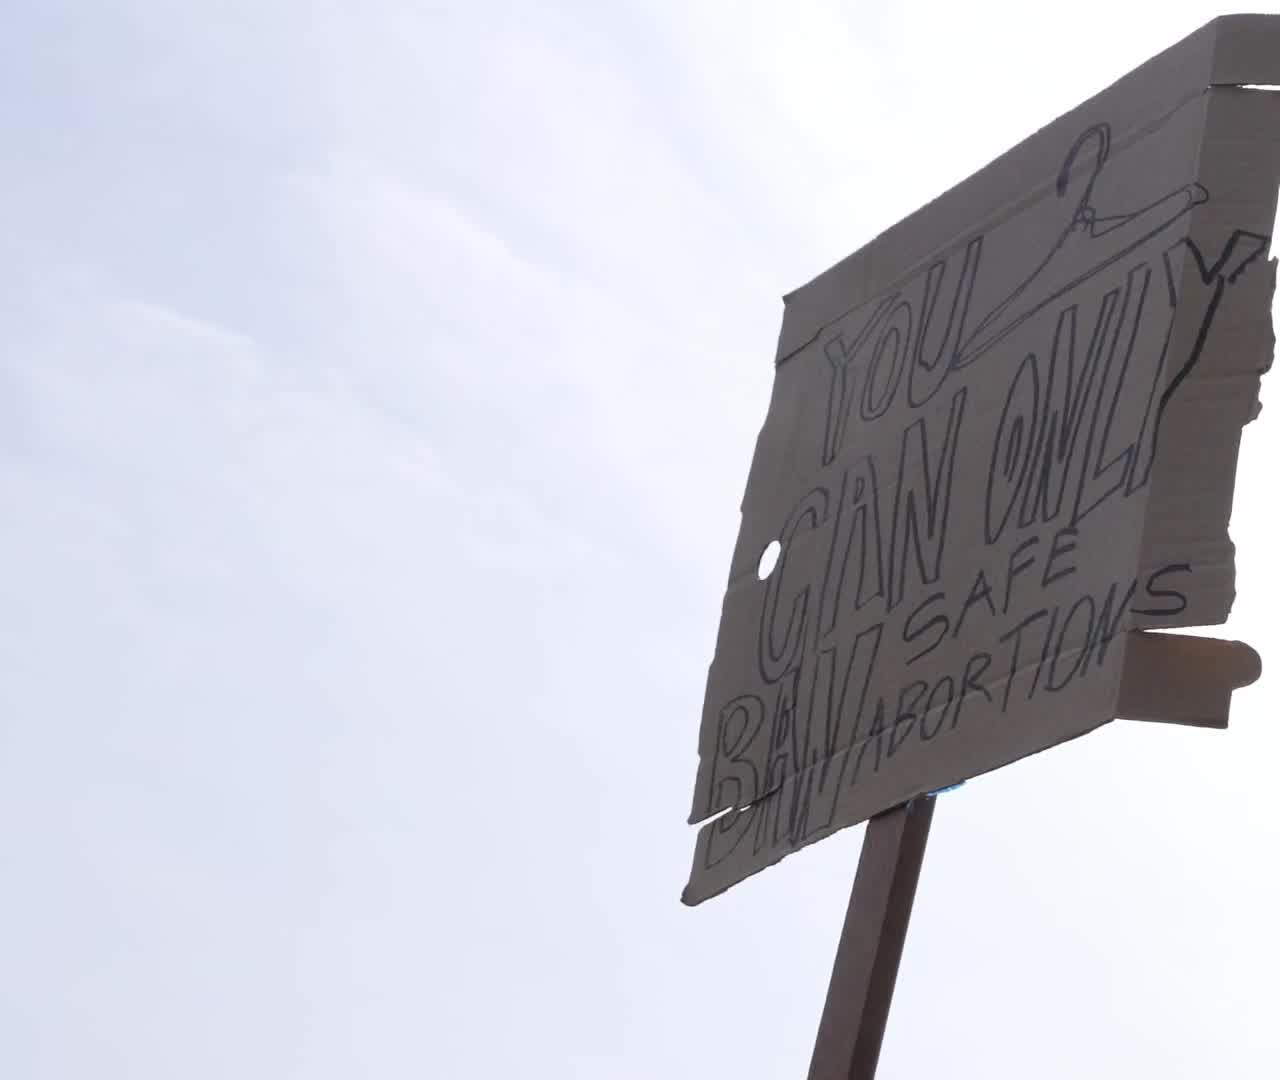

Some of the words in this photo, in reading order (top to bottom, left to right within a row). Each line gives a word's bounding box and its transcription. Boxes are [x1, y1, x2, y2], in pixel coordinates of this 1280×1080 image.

[757, 388, 967, 687] CAN
[984, 228, 1273, 546] ONLY
[821, 236, 984, 467] YOU
[849, 564, 1194, 788] ABORTIONS
[904, 529, 1081, 666] SAFE
